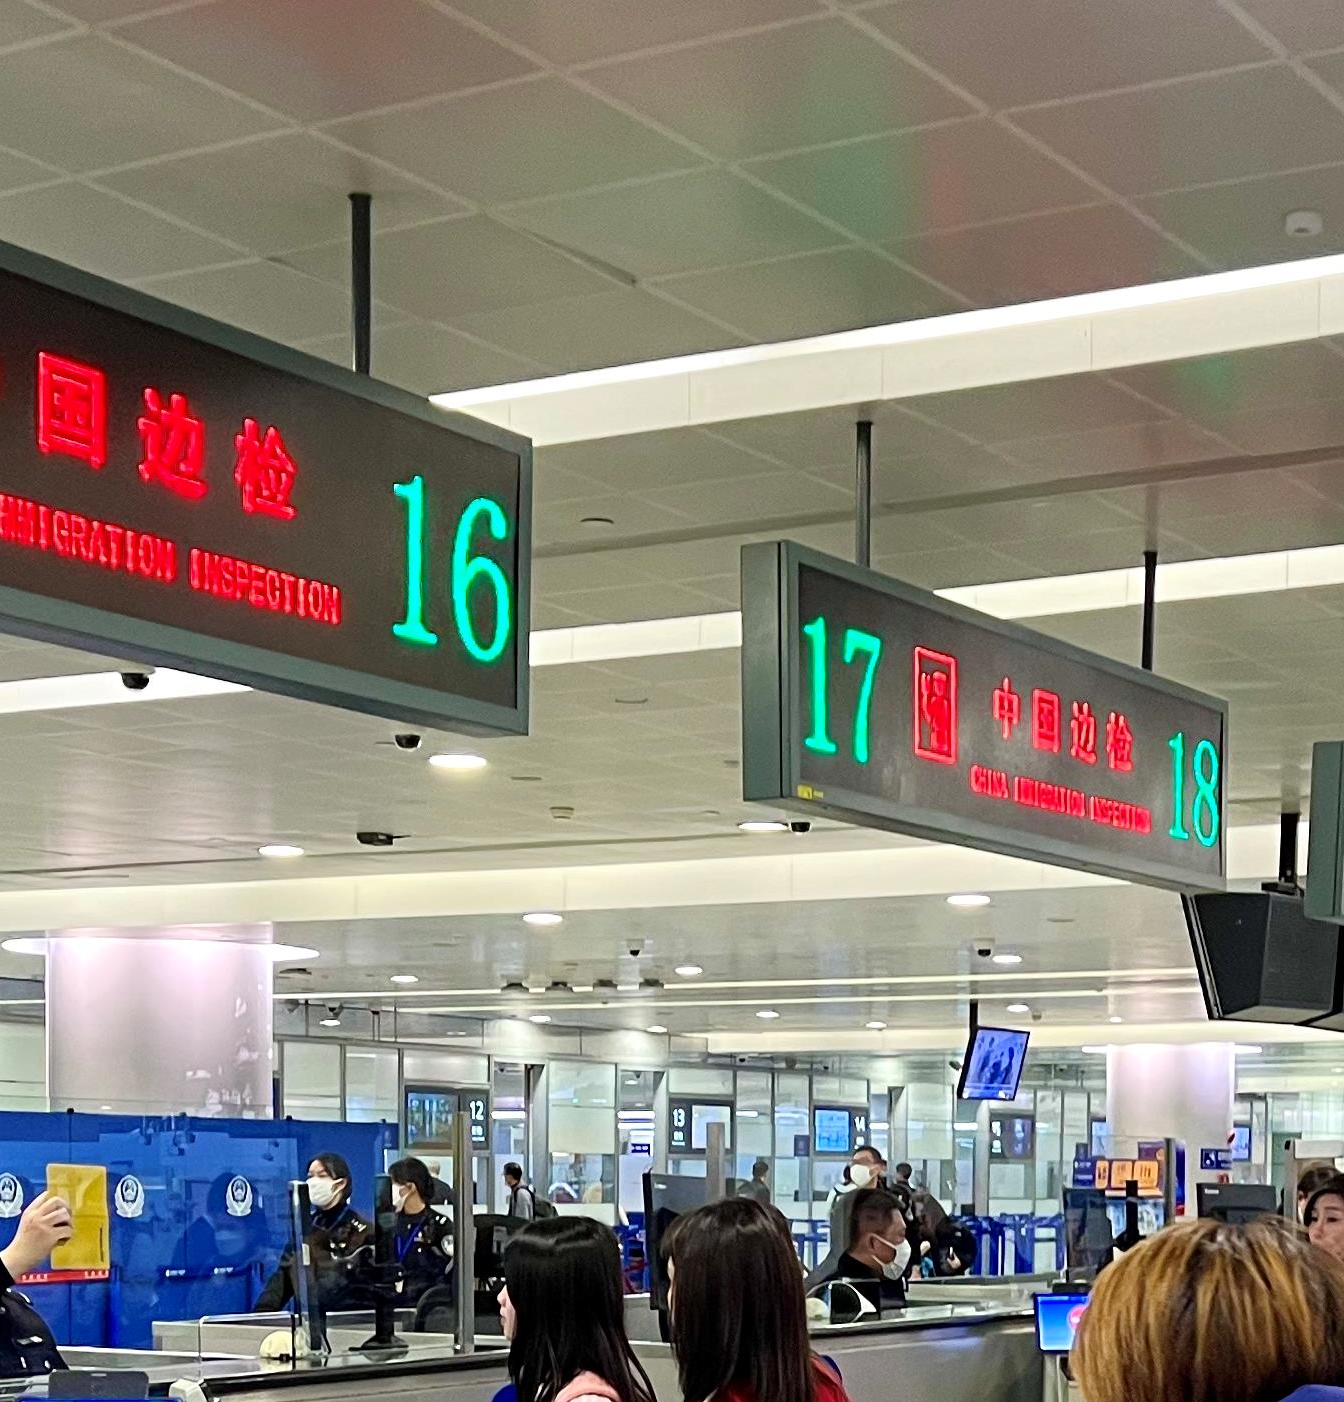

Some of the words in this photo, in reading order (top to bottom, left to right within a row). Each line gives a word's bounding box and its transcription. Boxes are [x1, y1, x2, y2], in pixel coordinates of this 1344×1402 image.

[189, 547, 342, 625] INSPECTION
[392, 474, 511, 664] 16
[803, 615, 881, 764] 17
[992, 676, 1134, 772] 中国边检
[1168, 731, 1220, 848] 18
[469, 1100, 484, 1120] 12
[672, 1108, 685, 1127] 13
